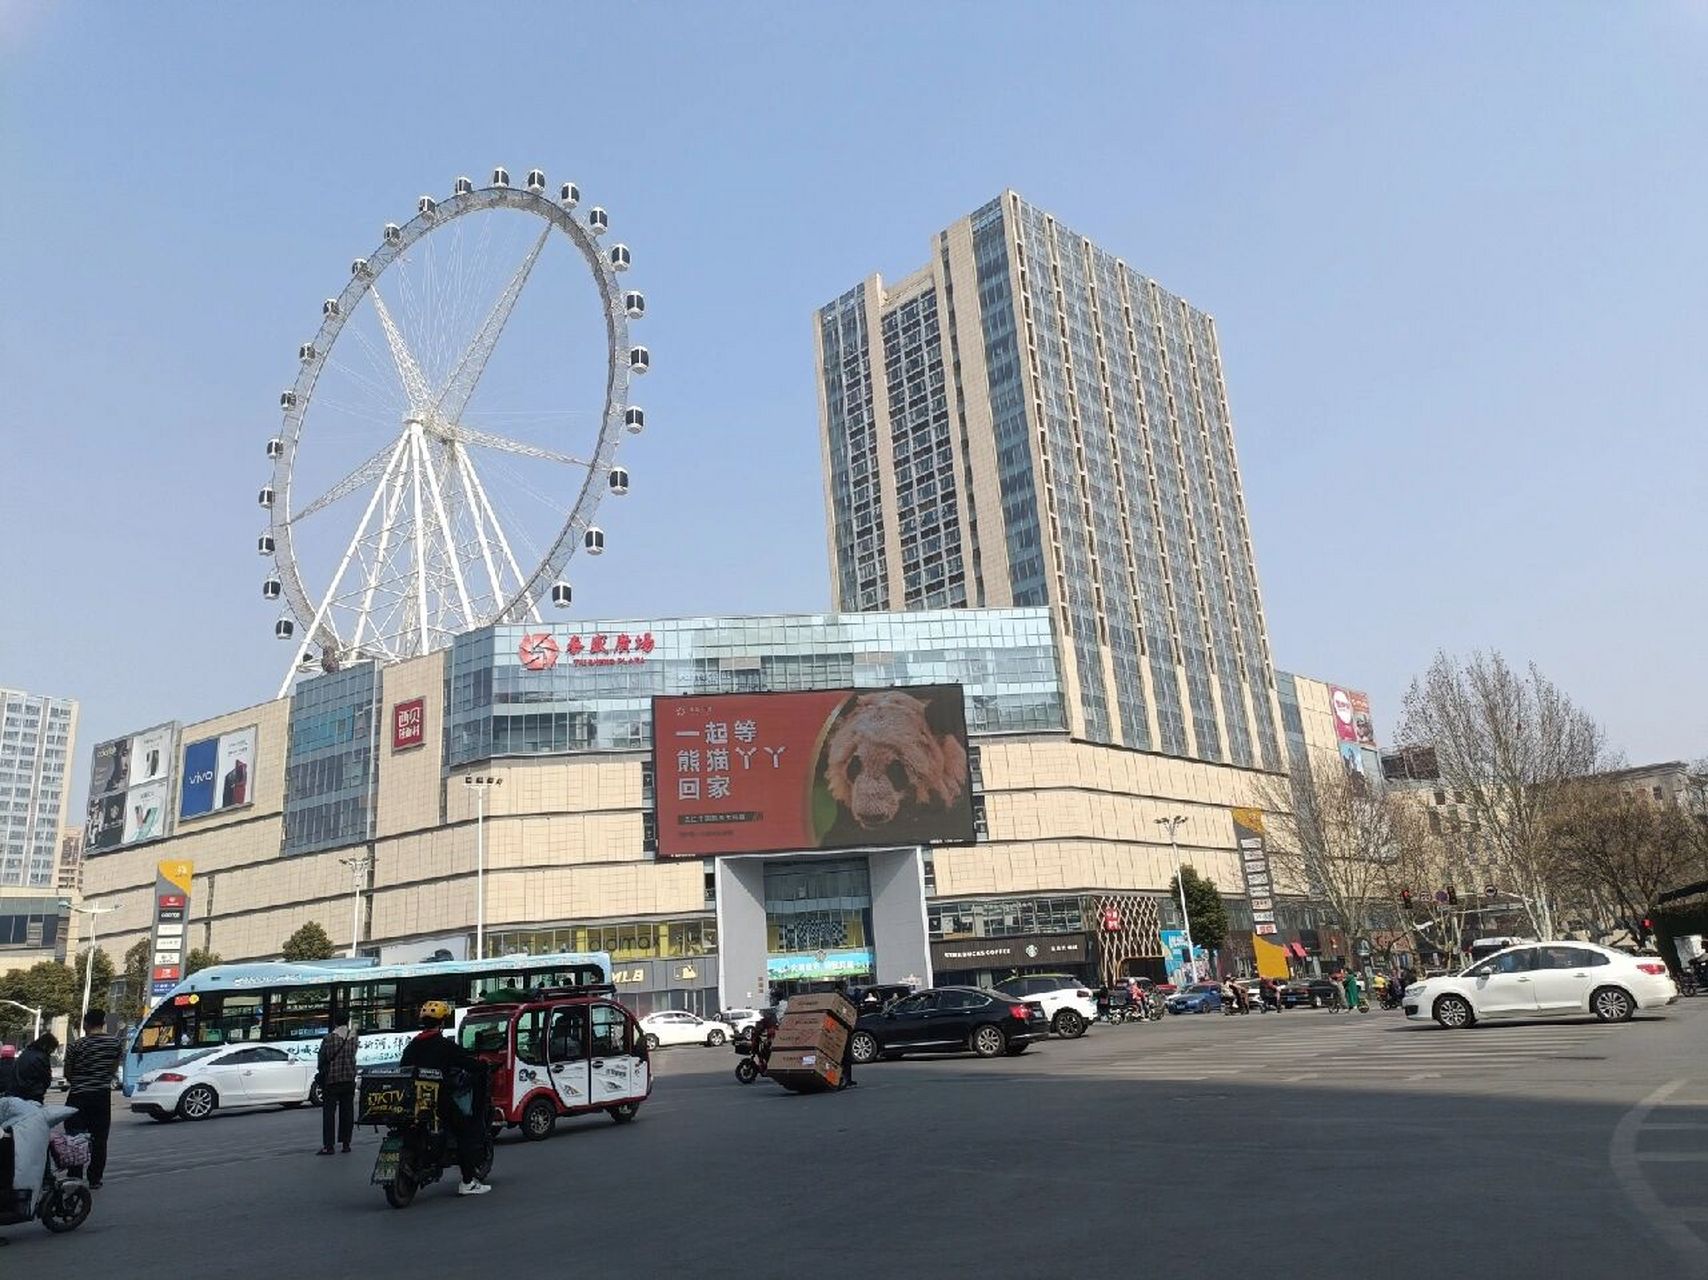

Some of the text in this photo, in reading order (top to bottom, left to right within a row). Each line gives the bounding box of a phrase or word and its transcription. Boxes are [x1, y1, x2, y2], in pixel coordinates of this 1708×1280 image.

[676, 720, 757, 744] 一起等
[676, 746, 786, 773] 熊猫丫丫
[188, 770, 213, 785] vivo
[678, 775, 731, 801] 回家
[985, 948, 1011, 956] COFFEE
[612, 968, 645, 983] MLB
